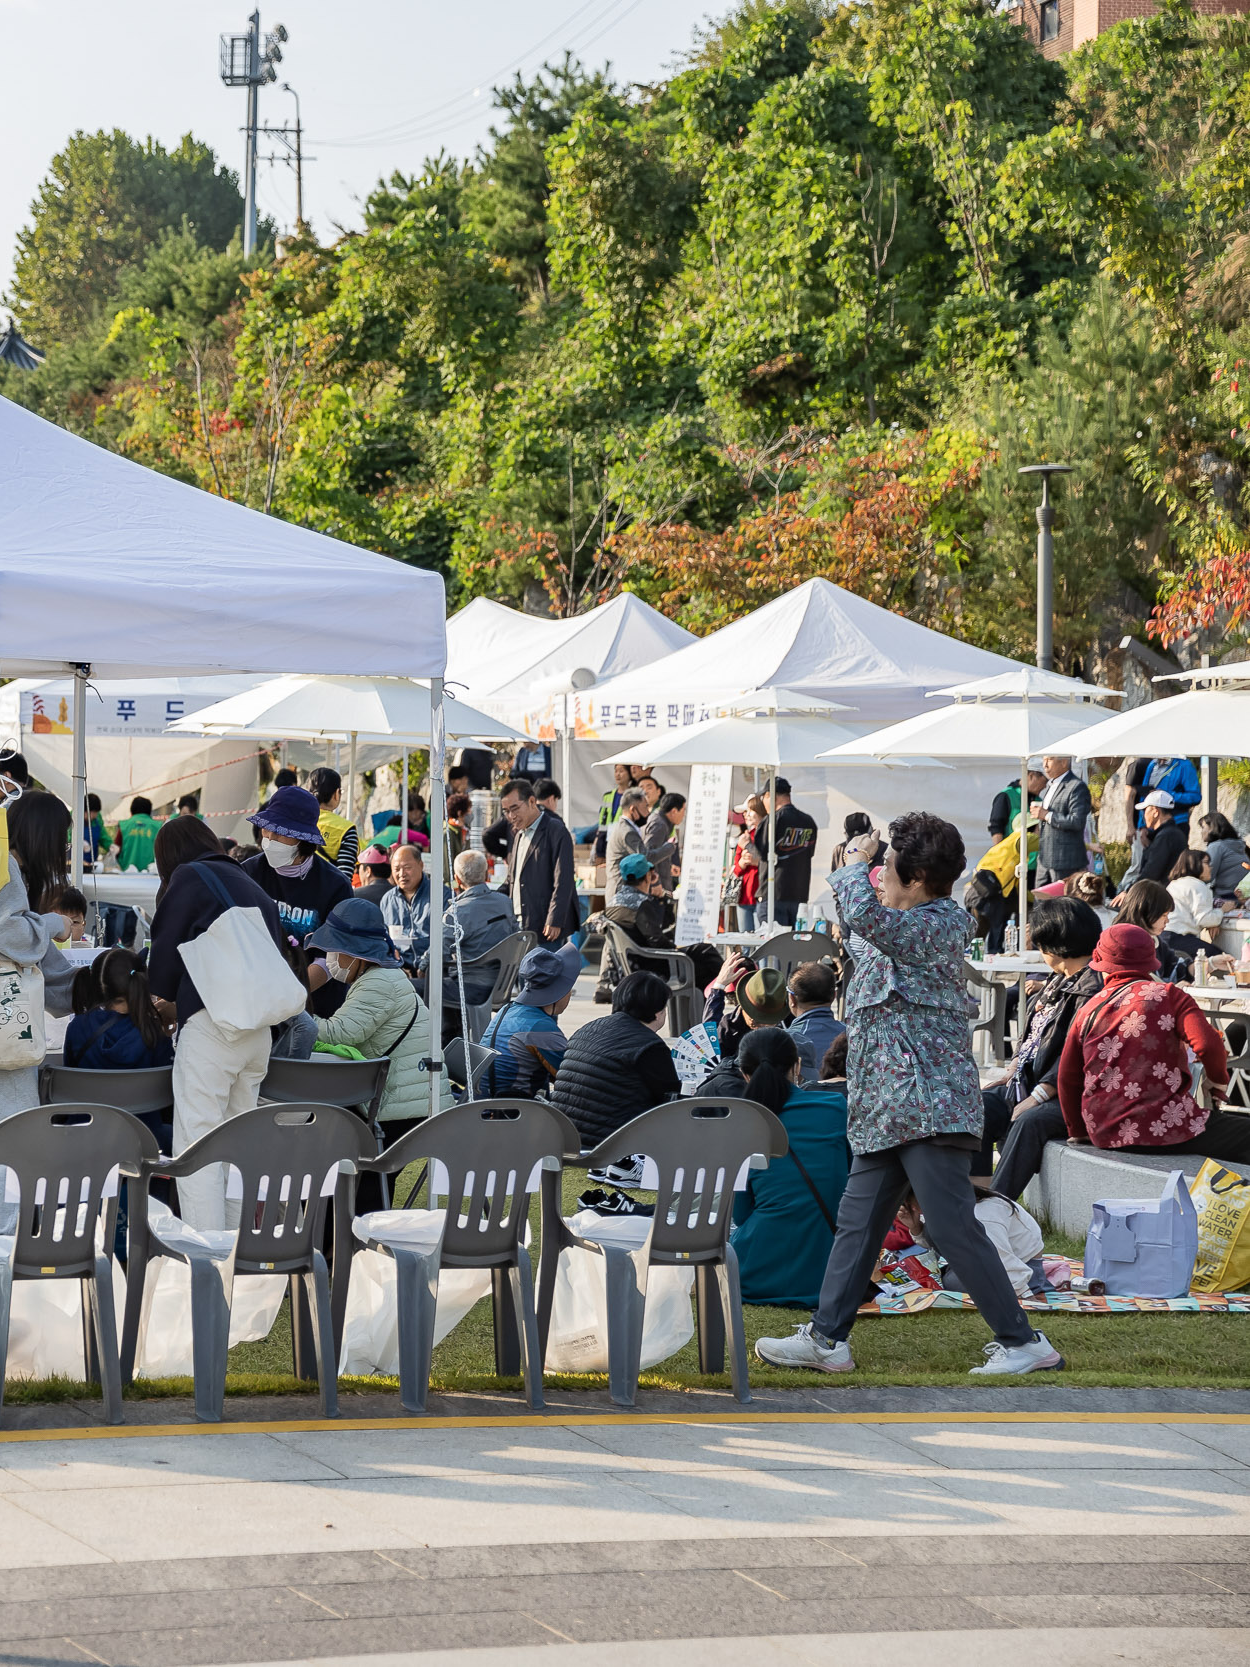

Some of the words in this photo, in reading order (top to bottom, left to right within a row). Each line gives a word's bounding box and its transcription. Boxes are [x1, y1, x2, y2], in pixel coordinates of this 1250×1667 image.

[601, 704, 657, 728] 푸드쿠폰
[1205, 1210, 1237, 1229] CLEAN
[1212, 1201, 1242, 1220] LOVE
